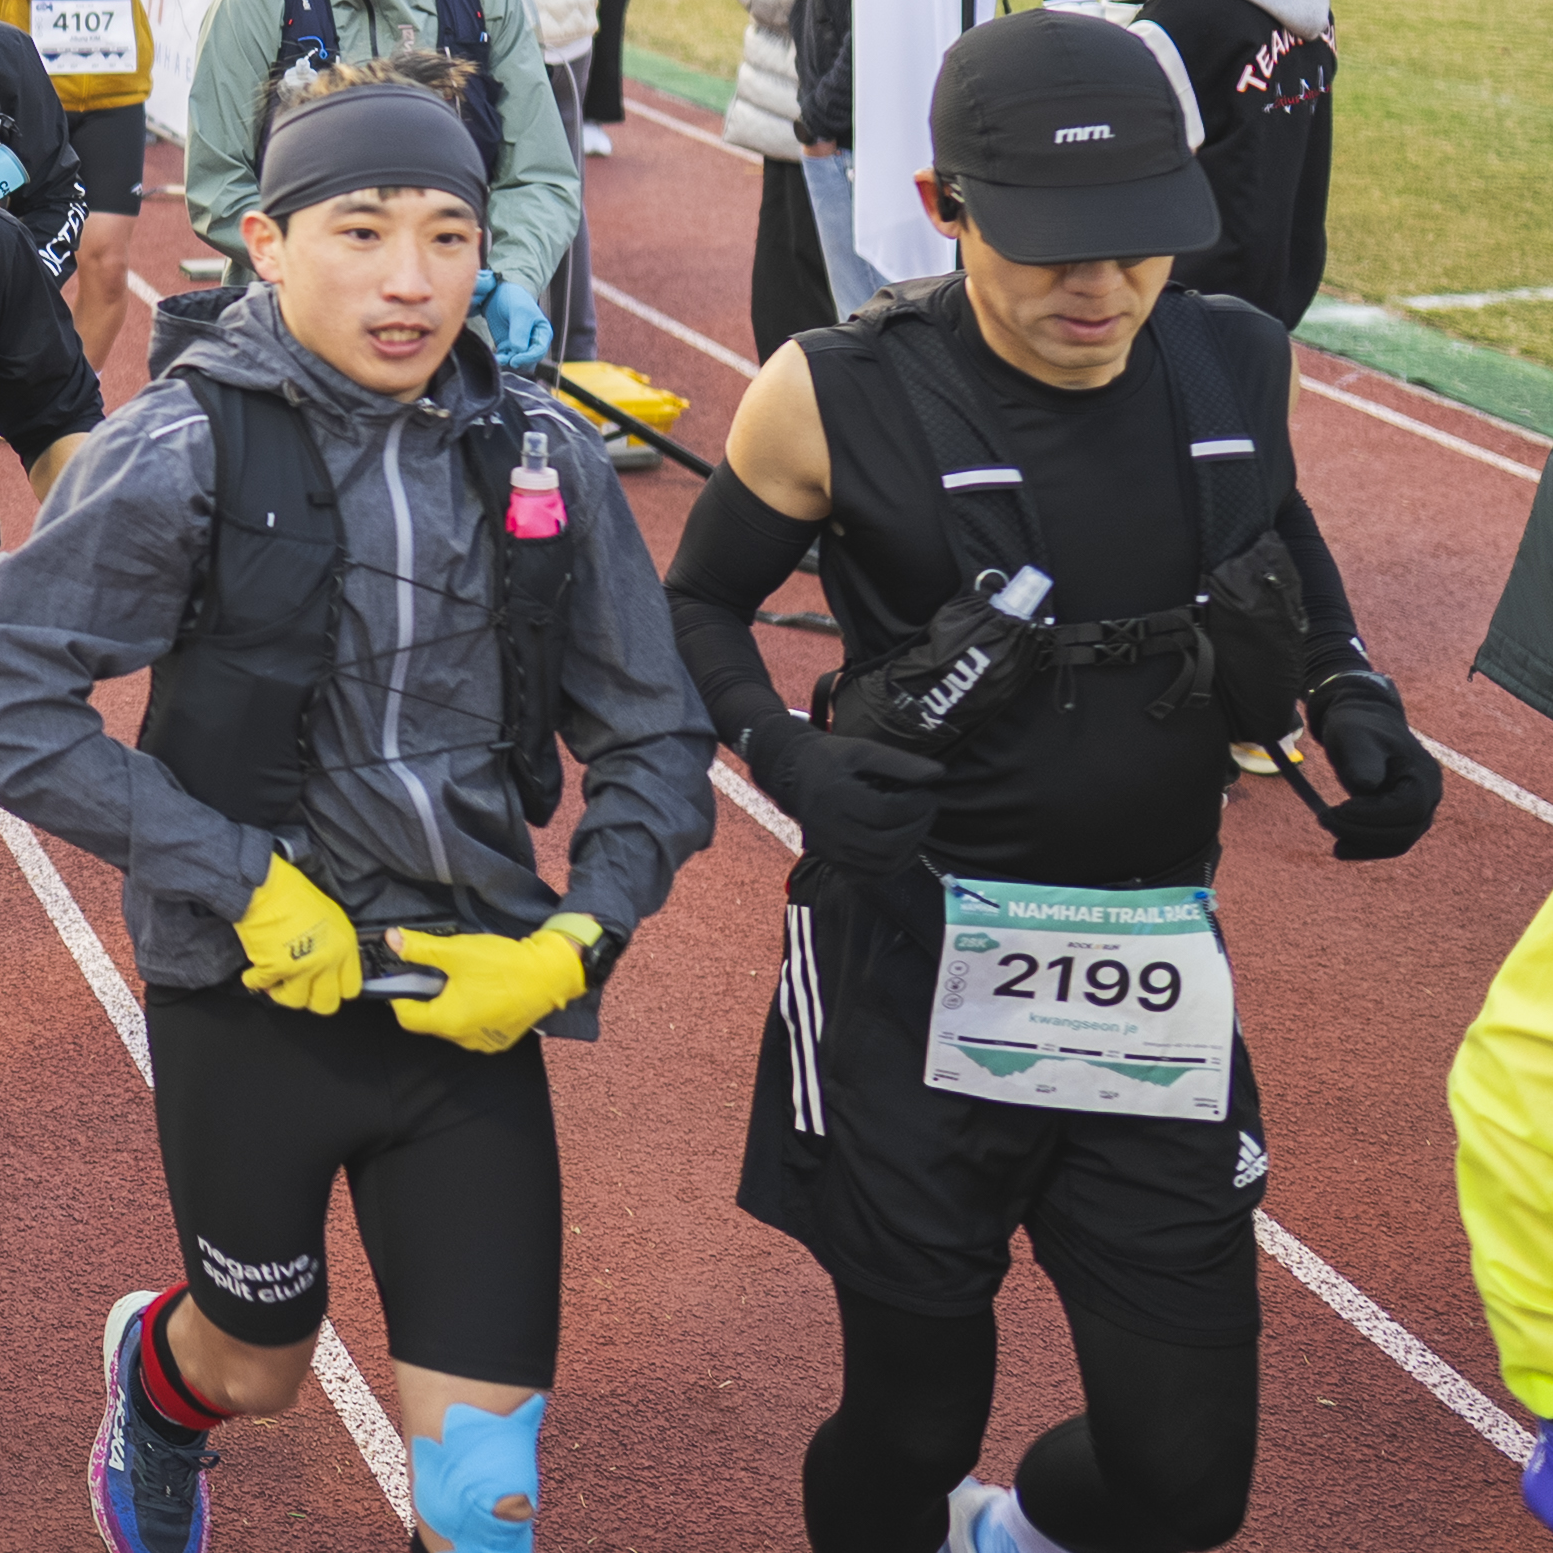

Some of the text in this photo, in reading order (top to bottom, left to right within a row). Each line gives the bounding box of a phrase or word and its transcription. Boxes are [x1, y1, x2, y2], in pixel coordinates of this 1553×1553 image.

[52, 12, 115, 33] 4107
[1008, 901, 1202, 923] NAMHAE TRAIL RACE
[992, 952, 1182, 1013] 2199
[1029, 1012, 1120, 1032] kwangseon
[197, 1233, 310, 1283] negative
[202, 1258, 315, 1304] split club
[108, 1384, 126, 1473] HOKA
